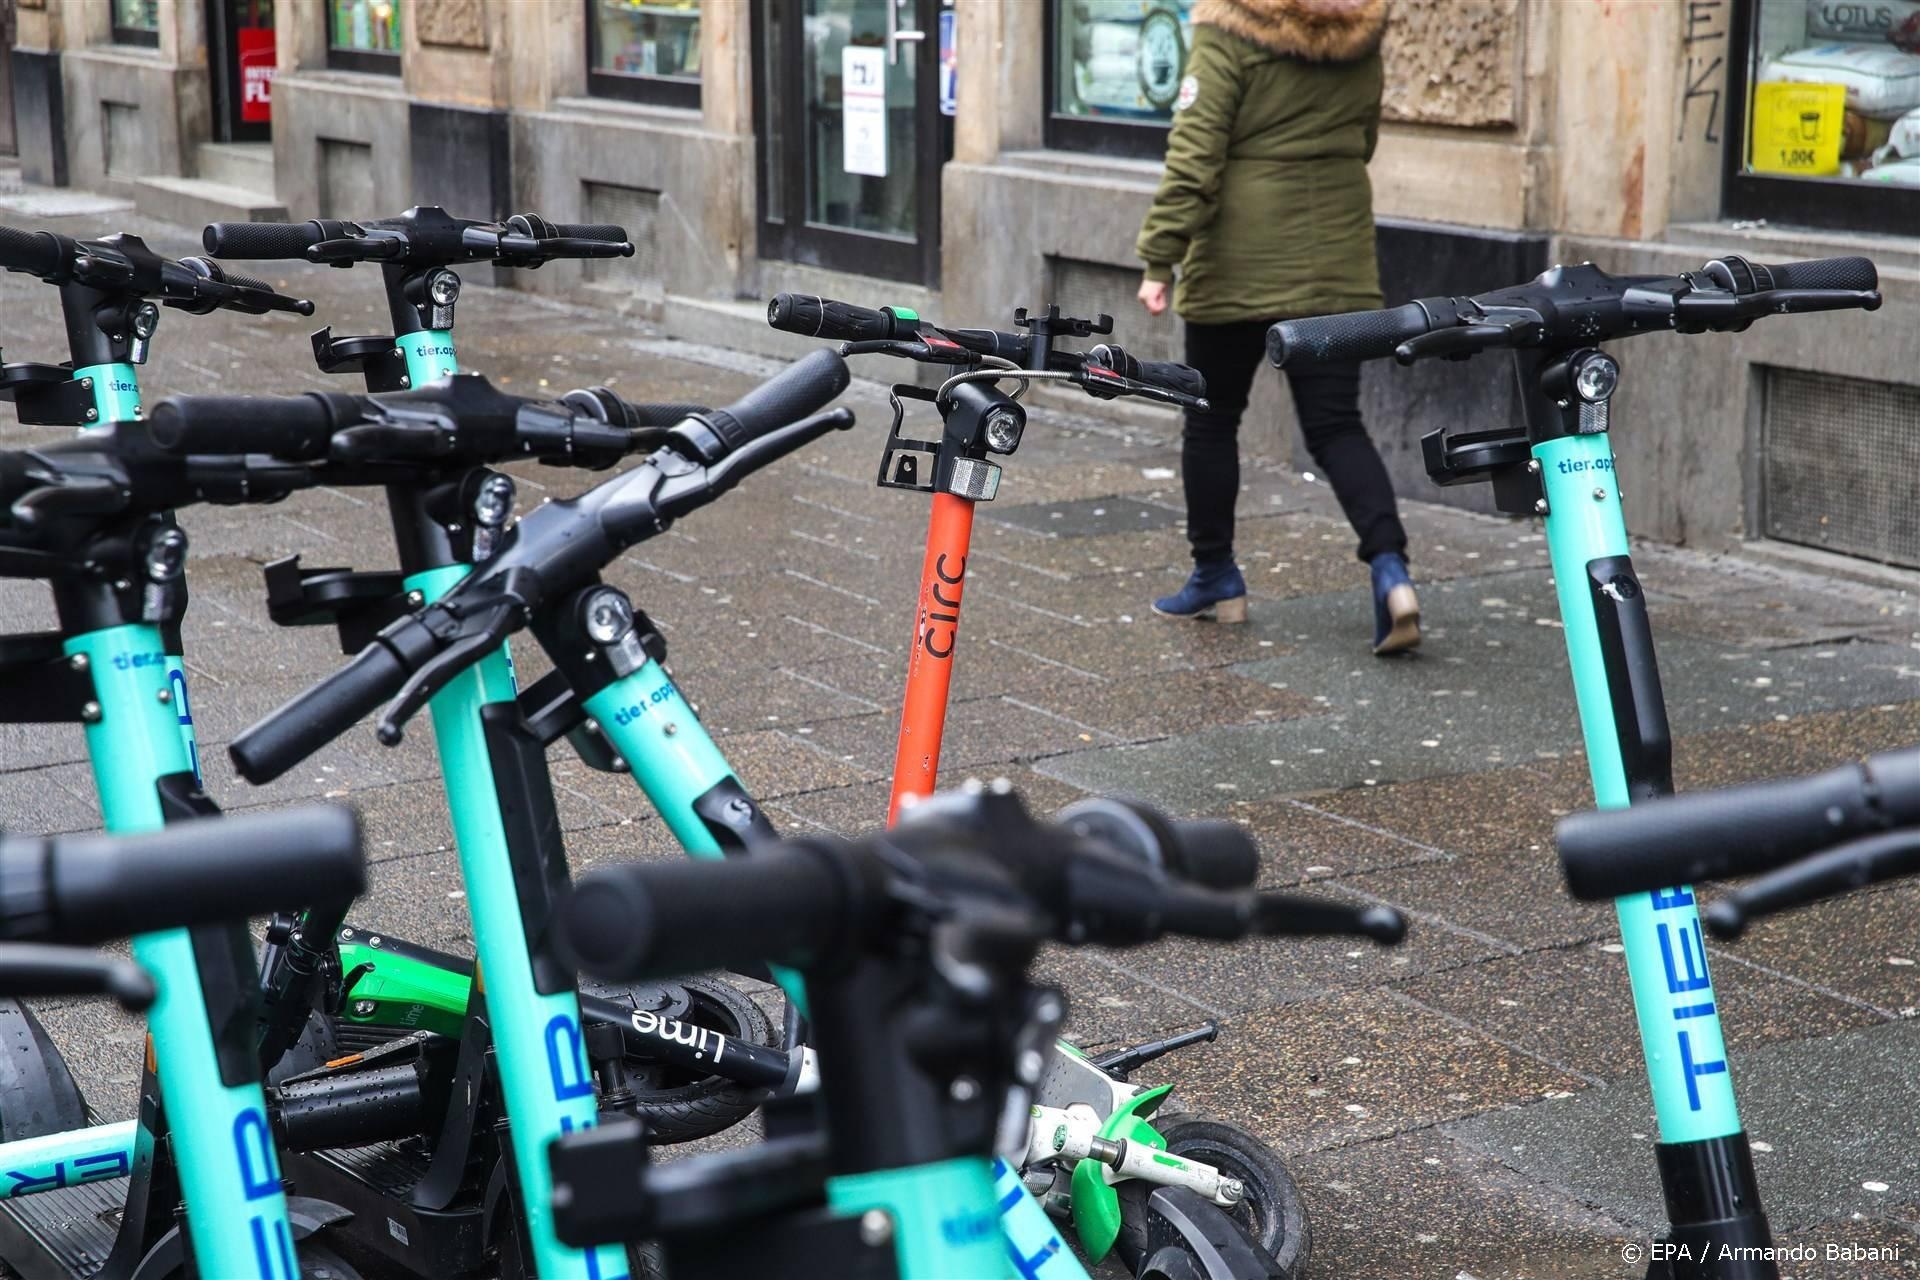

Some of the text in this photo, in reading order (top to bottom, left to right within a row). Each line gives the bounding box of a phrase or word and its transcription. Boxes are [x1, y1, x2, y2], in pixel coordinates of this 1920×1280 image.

[1823, 5, 1892, 28] LOTUS
[924, 553, 966, 659] circ
[631, 1009, 726, 1064] Lime
[1651, 885, 1727, 1112] TIE
